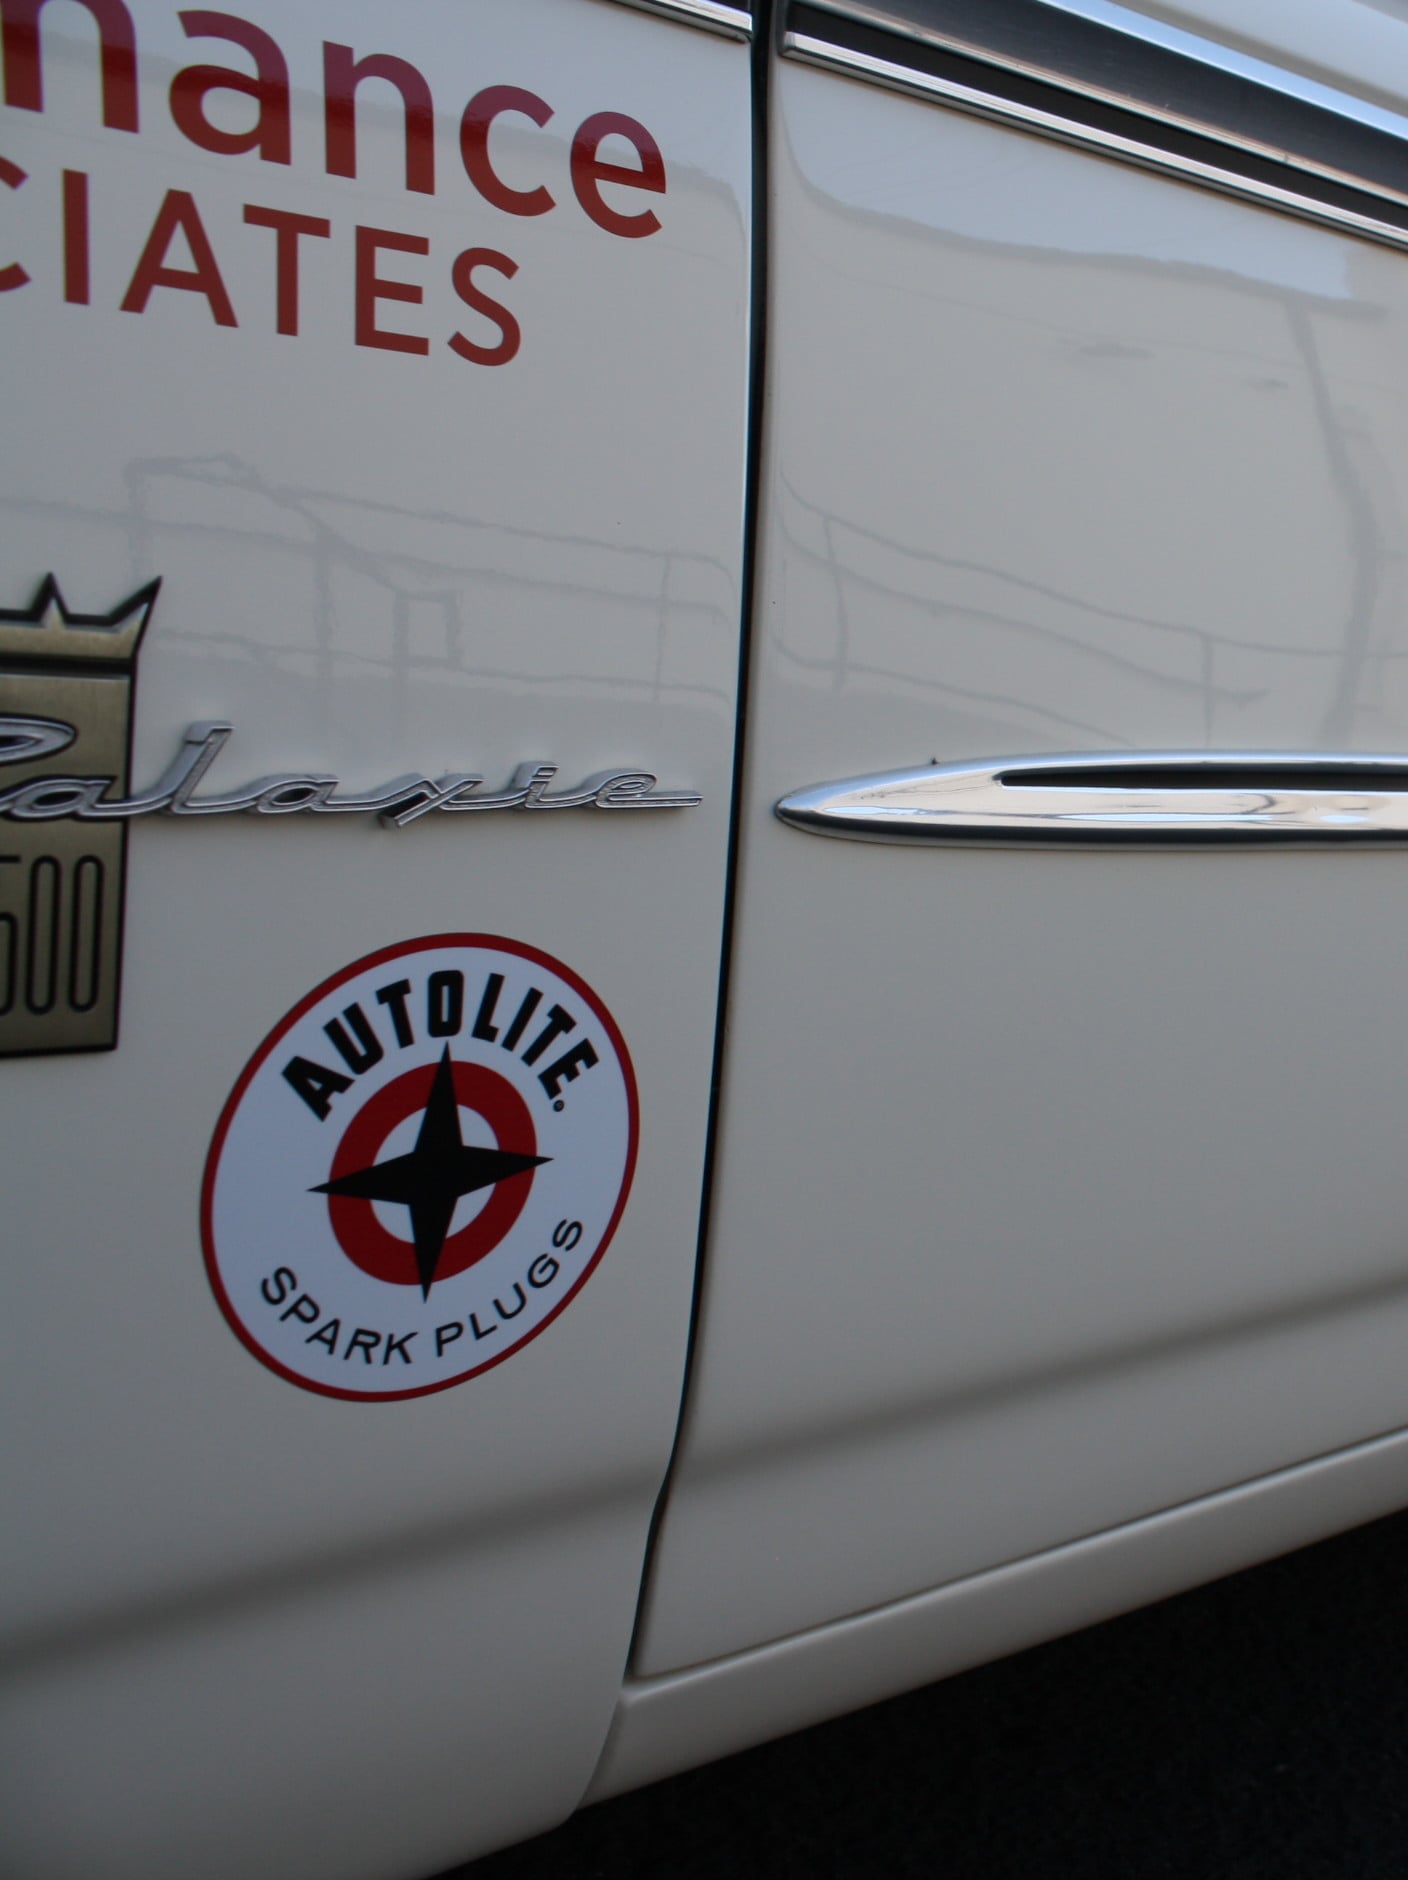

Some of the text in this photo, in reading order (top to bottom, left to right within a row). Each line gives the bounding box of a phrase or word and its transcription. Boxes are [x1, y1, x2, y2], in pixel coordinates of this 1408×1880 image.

[0, 155, 521, 367] IATES
[281, 969, 599, 1122] AUTOLITE
[260, 1218, 583, 1366] SPARK PLUGS
